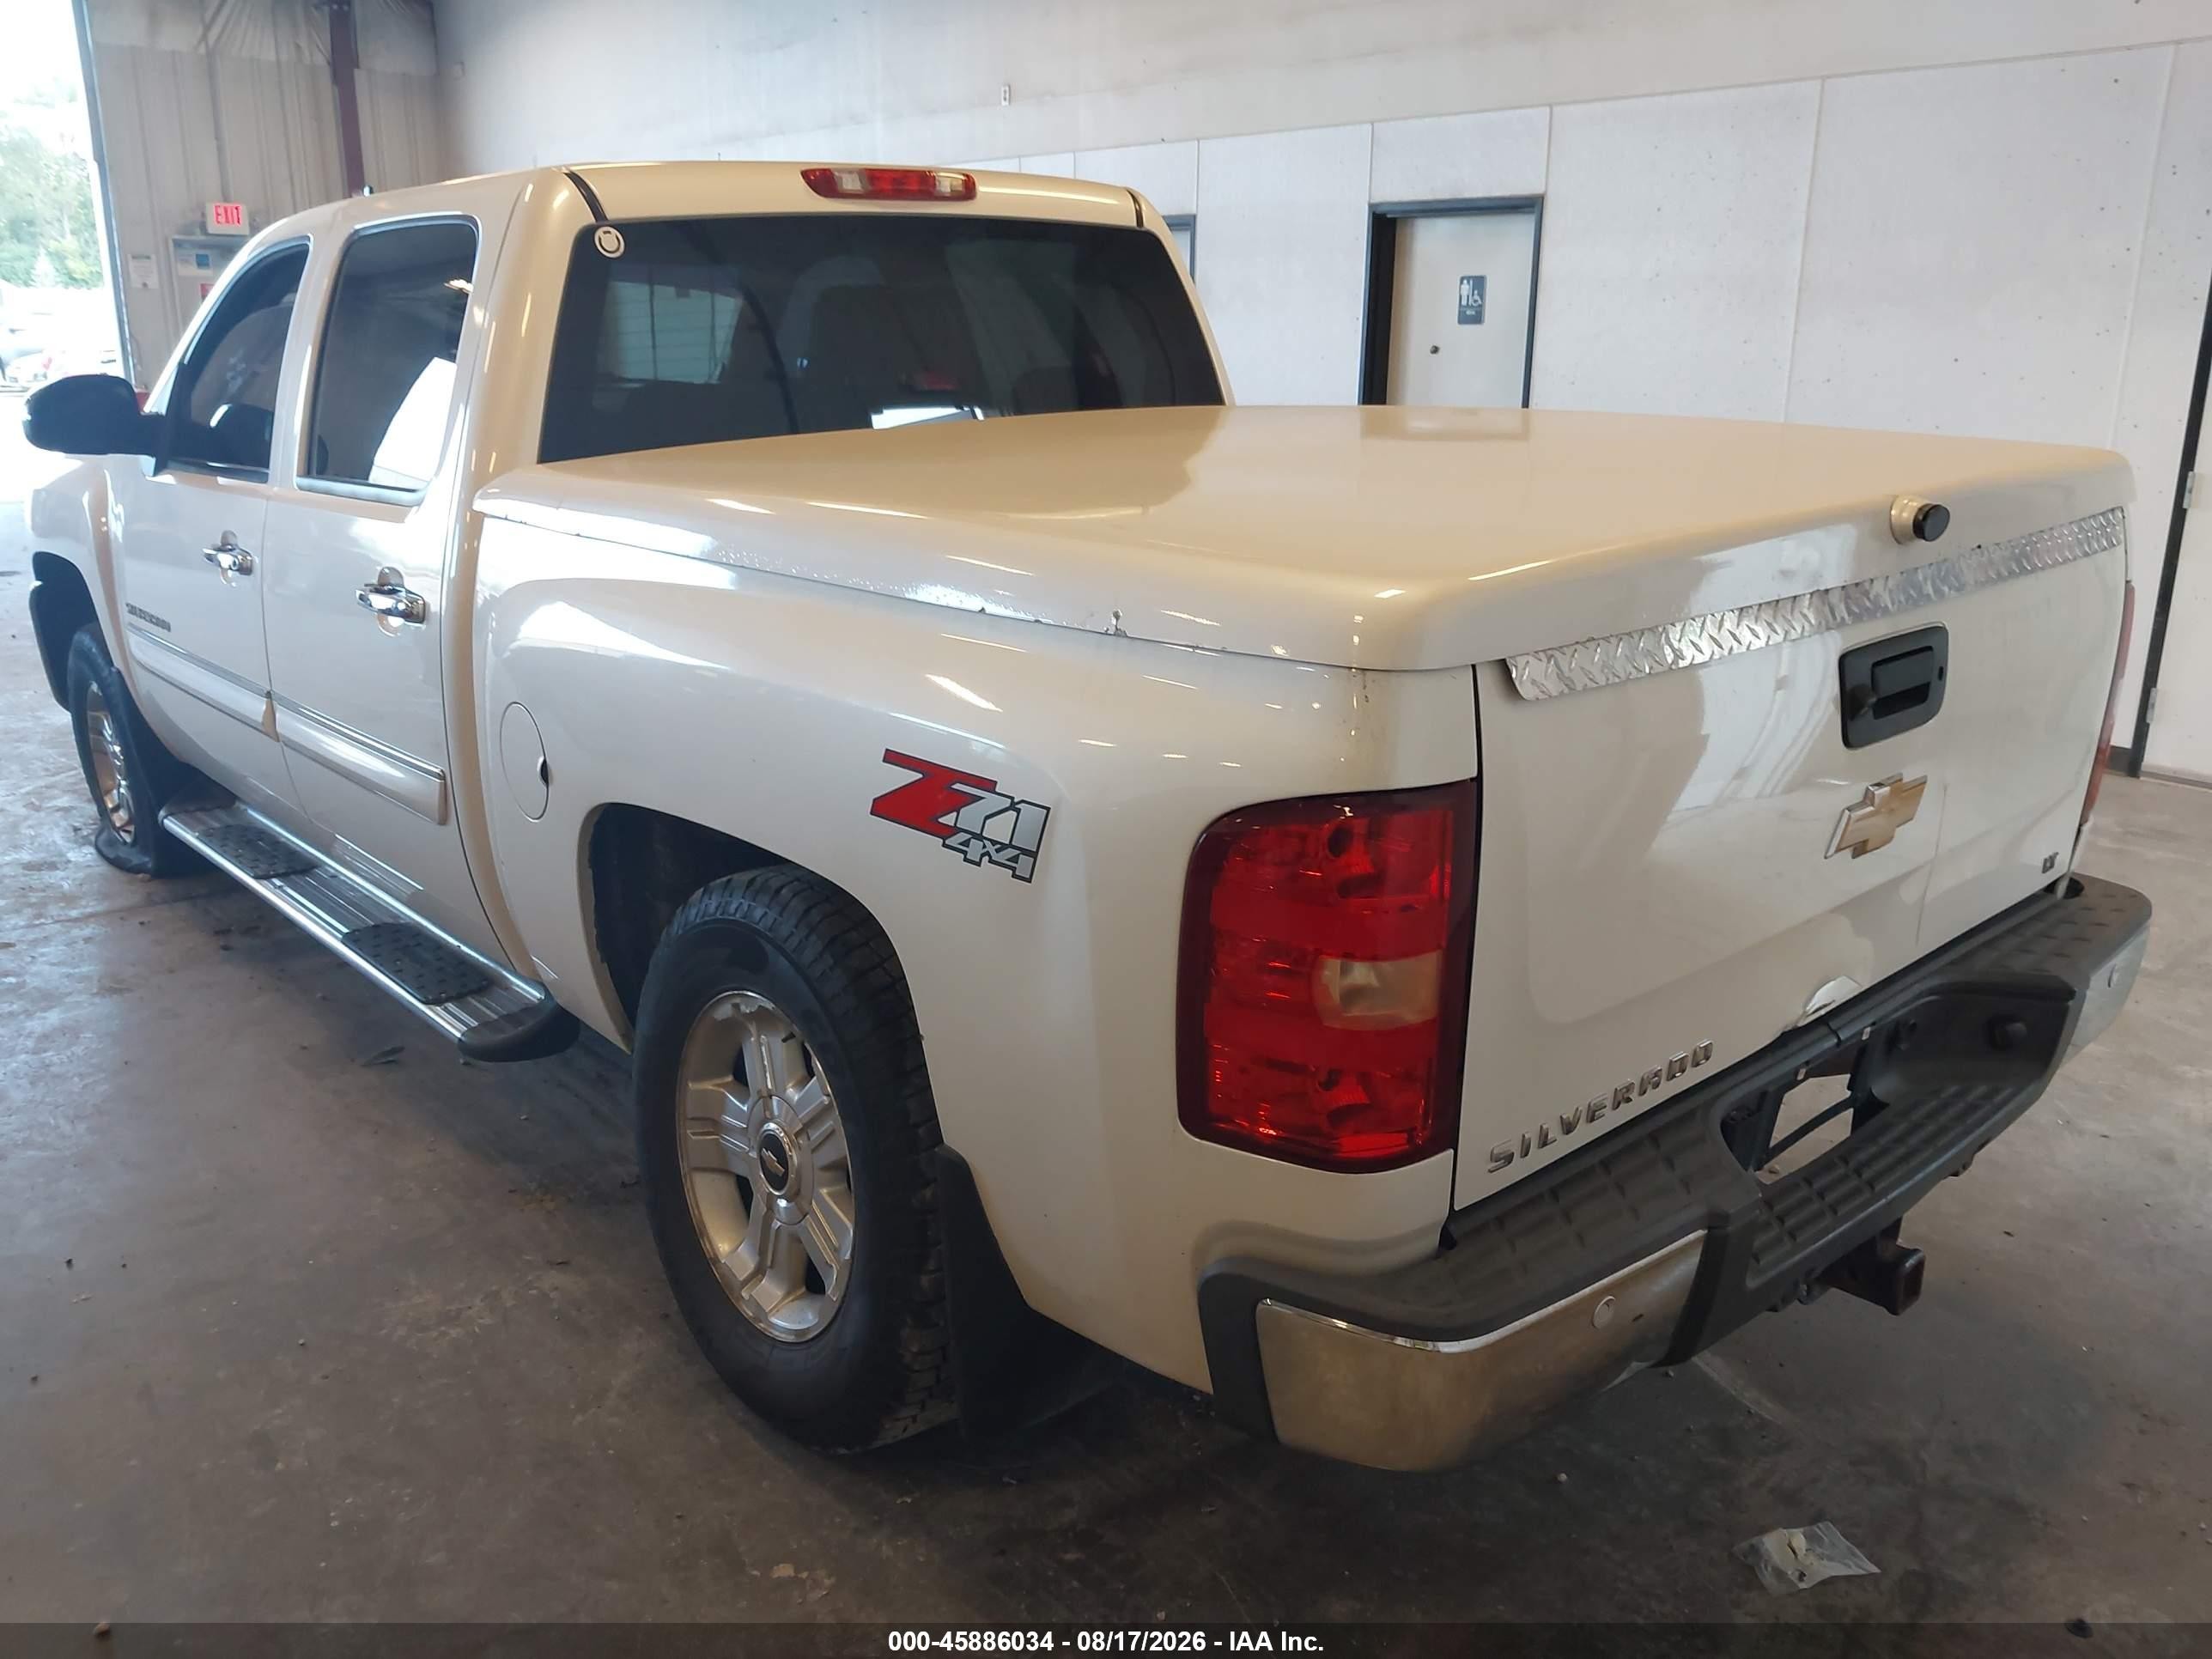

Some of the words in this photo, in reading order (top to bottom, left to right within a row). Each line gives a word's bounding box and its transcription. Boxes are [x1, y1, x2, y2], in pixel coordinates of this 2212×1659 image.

[214, 203, 242, 226] EXIT
[870, 748, 1051, 854] Z71
[1487, 1037, 1714, 1174] SILVERADO
